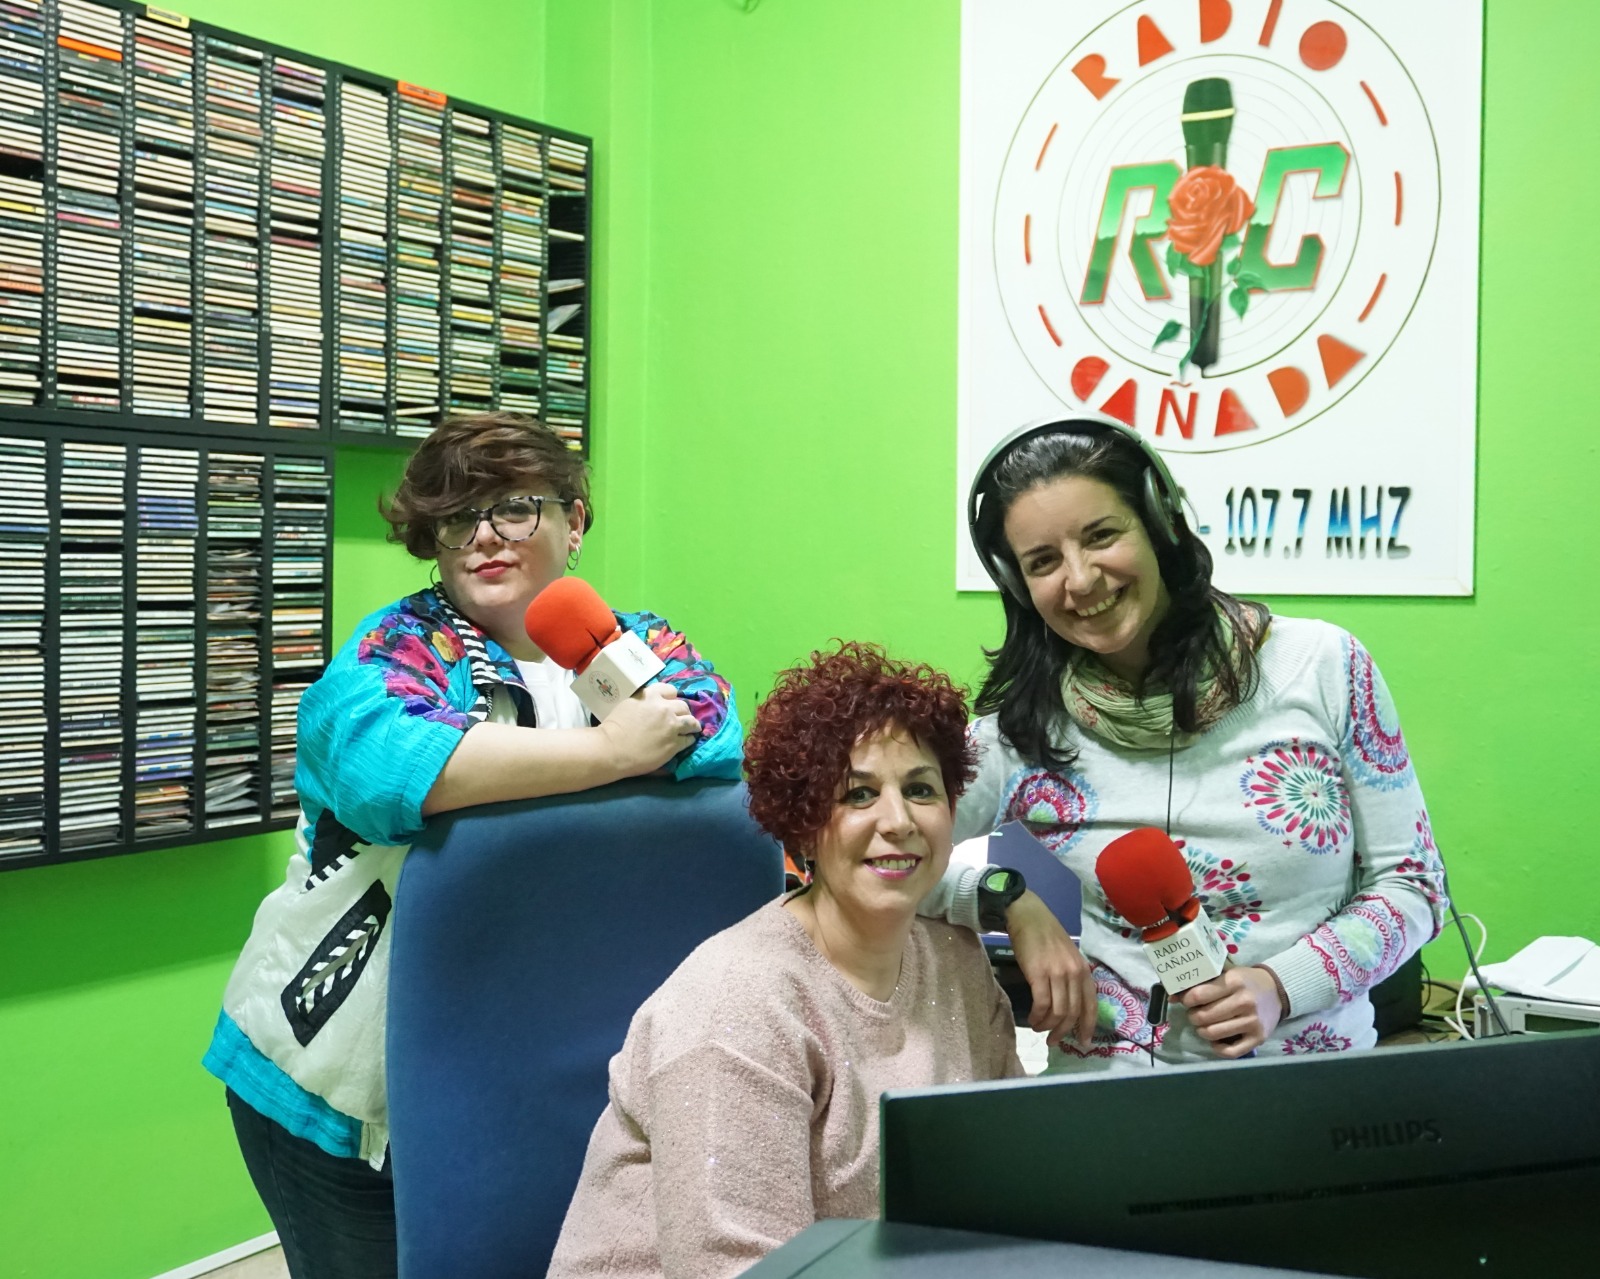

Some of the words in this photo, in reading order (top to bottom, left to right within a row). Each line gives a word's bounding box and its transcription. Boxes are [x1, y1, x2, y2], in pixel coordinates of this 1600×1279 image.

[1071, 0, 1348, 101] RADIO
[1071, 334, 1367, 439] CAÑADA
[1225, 486, 1313, 559] 107.7
[1326, 485, 1412, 560] MHZ
[1153, 938, 1191, 959] RADIO
[1156, 949, 1204, 974] CAÑADA
[1176, 968, 1200, 982] 107.7
[1331, 1119, 1442, 1150] PHILIPS
